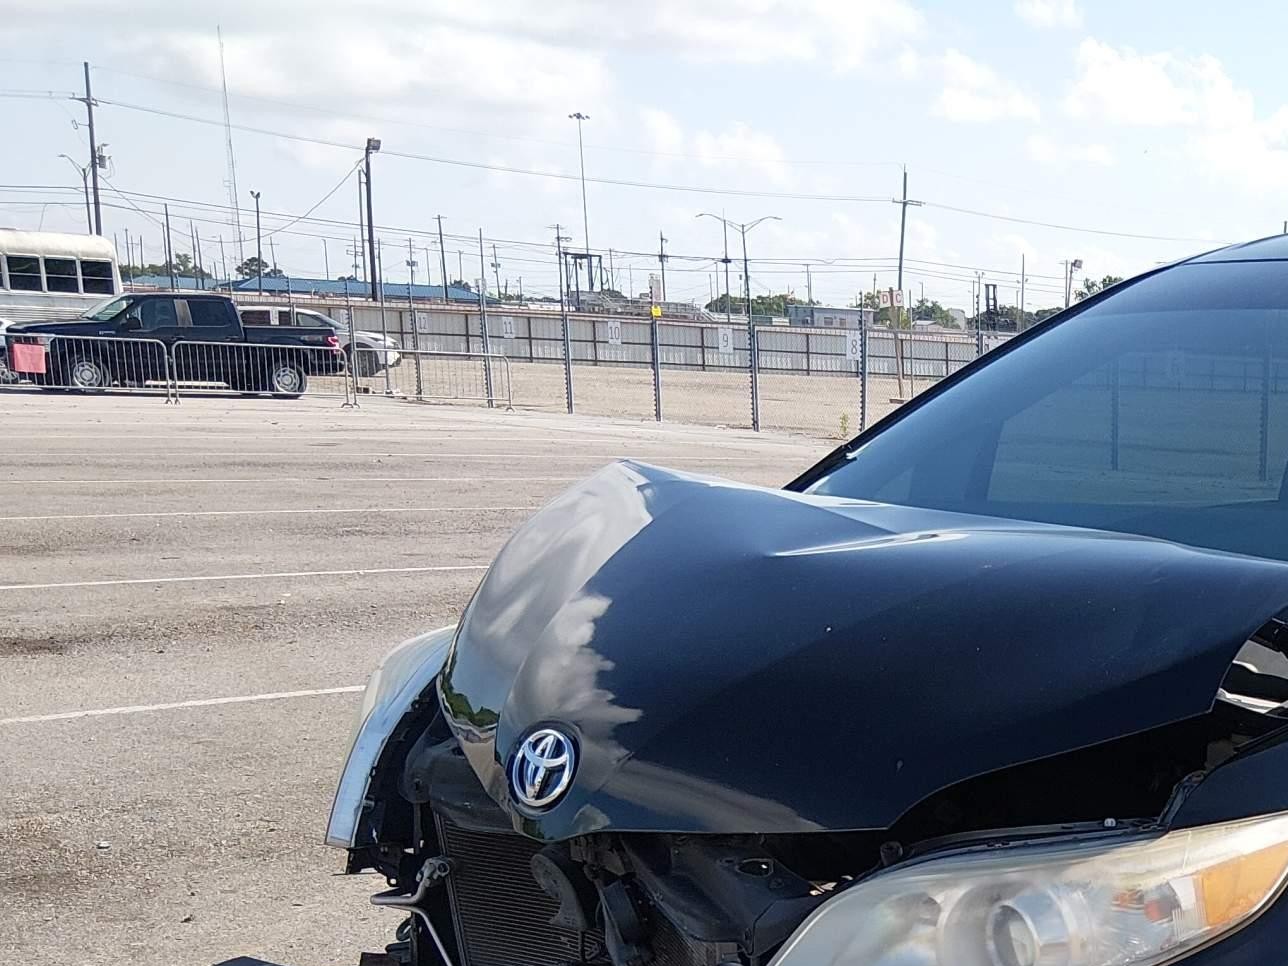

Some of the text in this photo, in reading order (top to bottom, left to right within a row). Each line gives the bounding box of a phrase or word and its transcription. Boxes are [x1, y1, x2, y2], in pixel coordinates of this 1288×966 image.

[882, 294, 889, 304] D
[895, 293, 902, 304] C
[504, 321, 513, 334] 11
[609, 326, 620, 340] 10
[722, 334, 729, 347] 9
[851, 340, 858, 354] 8
